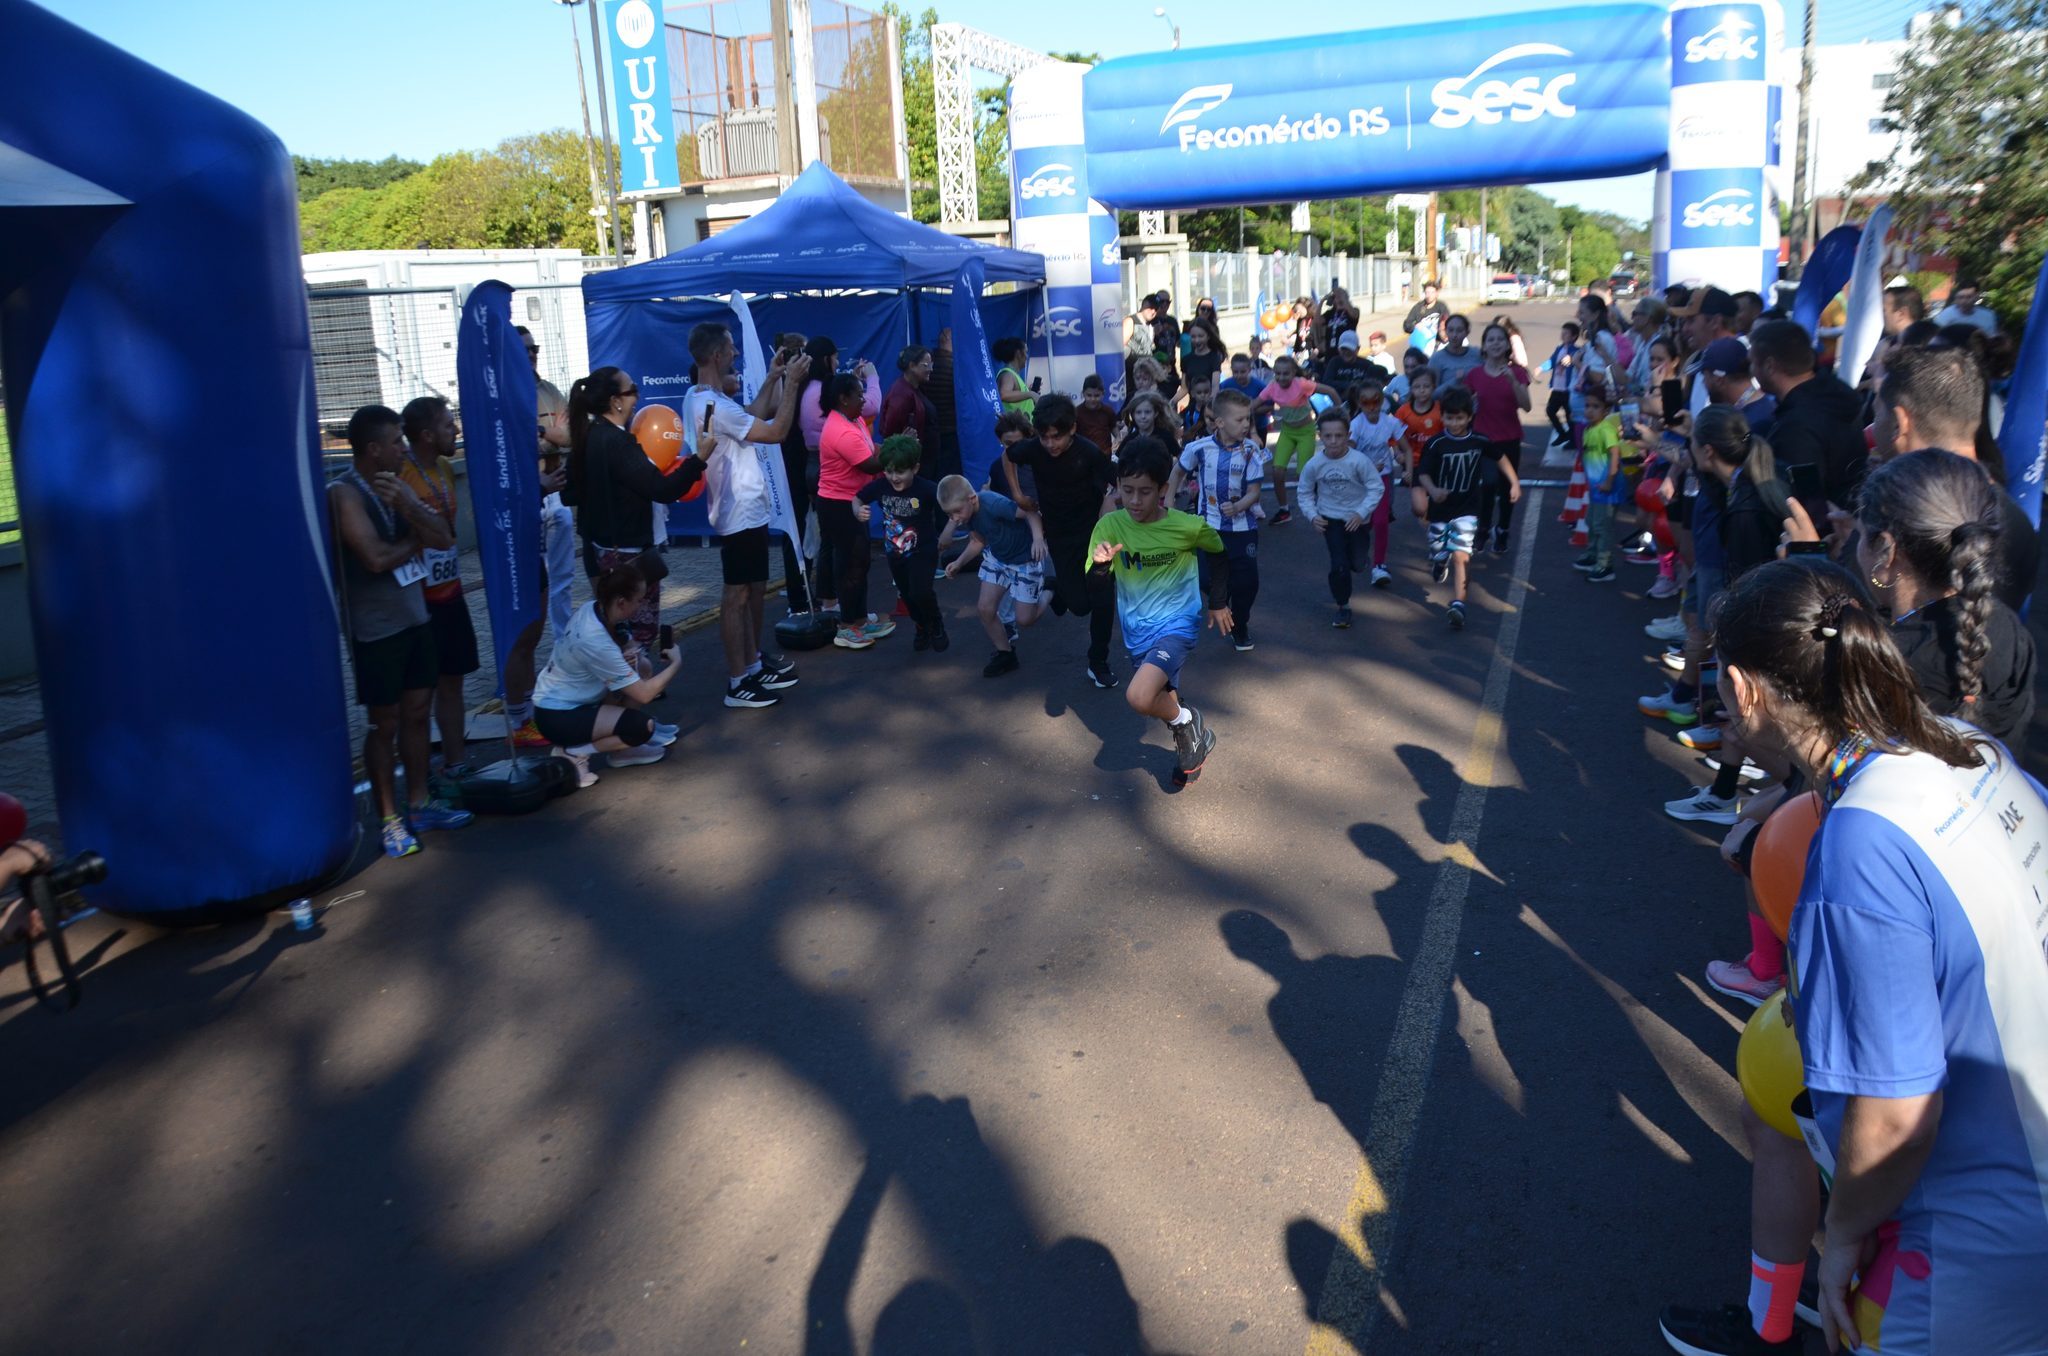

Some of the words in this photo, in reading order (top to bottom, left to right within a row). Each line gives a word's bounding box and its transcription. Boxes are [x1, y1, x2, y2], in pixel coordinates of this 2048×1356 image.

[624, 55, 663, 189] URI
[1178, 111, 1342, 153] Fecomércio
[1349, 106, 1391, 138] RS
[642, 373, 692, 387] Fecomérc
[979, 338, 993, 379] Sindicatos
[494, 419, 511, 489] Sindicatos
[1438, 448, 1482, 493] NY
[505, 532, 521, 611] Fecomércio
